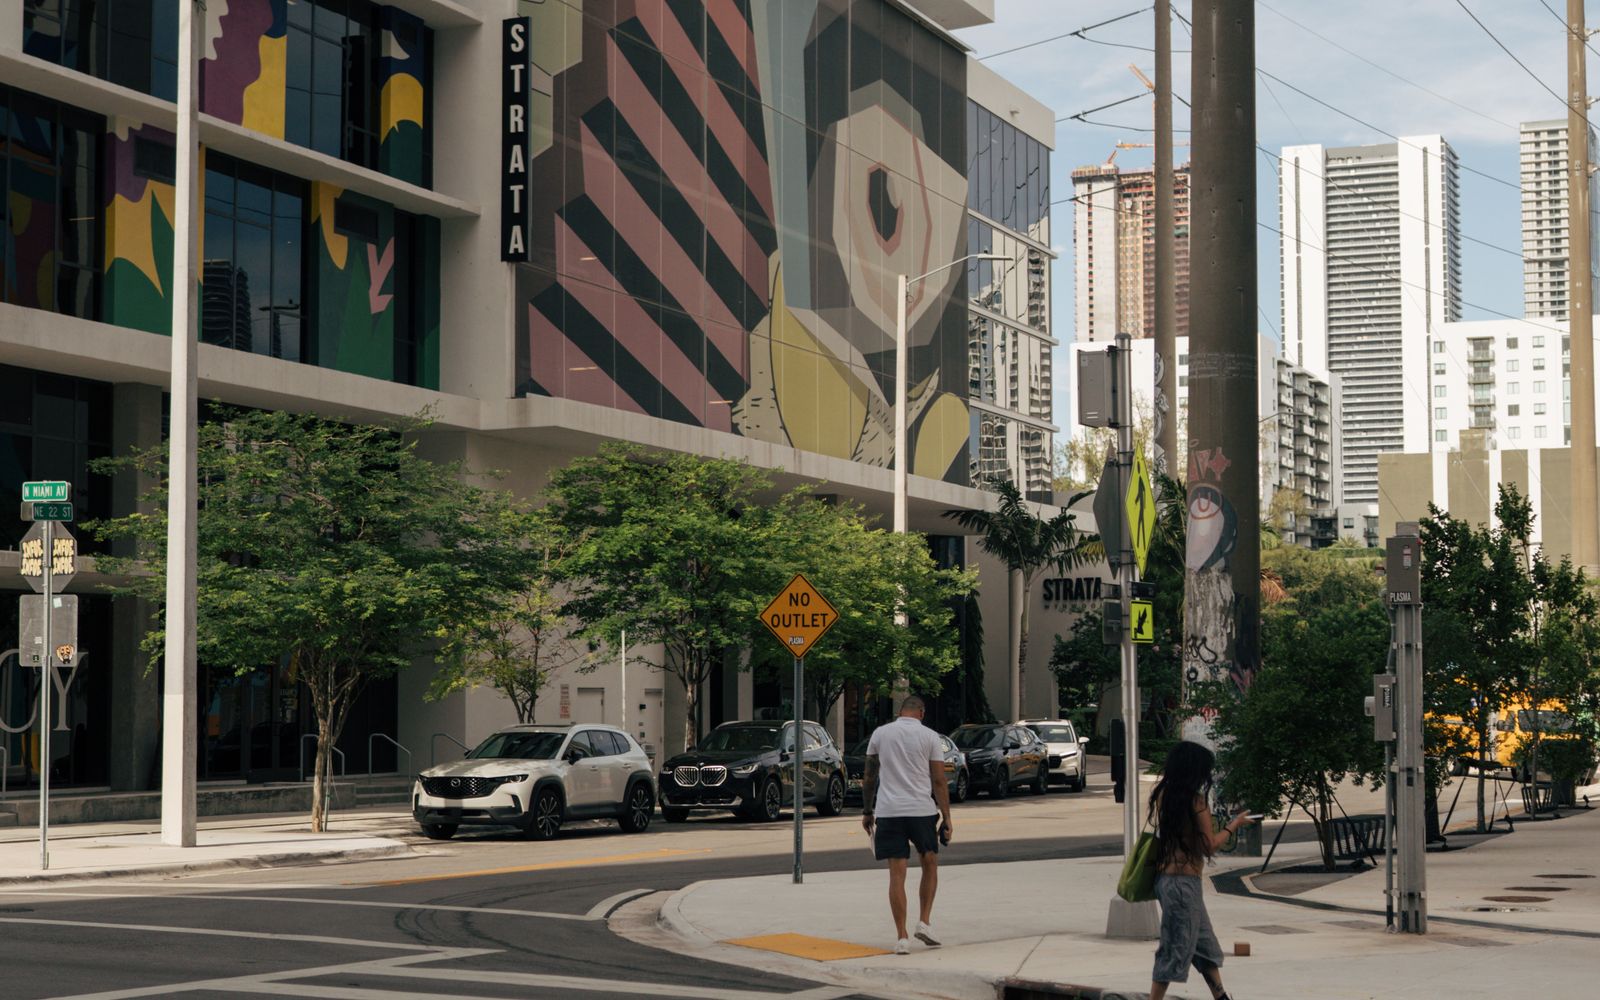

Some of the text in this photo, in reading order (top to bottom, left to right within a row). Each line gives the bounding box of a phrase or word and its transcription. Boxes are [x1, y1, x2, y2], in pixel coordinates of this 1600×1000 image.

[509, 24, 525, 254] STRATA
[25, 486, 65, 497] N MIAMI AV
[34, 506, 72, 518] NE 22 ST
[1043, 577, 1102, 601] STRATA
[789, 592, 810, 607] NO
[771, 613, 829, 628] OUTLET
